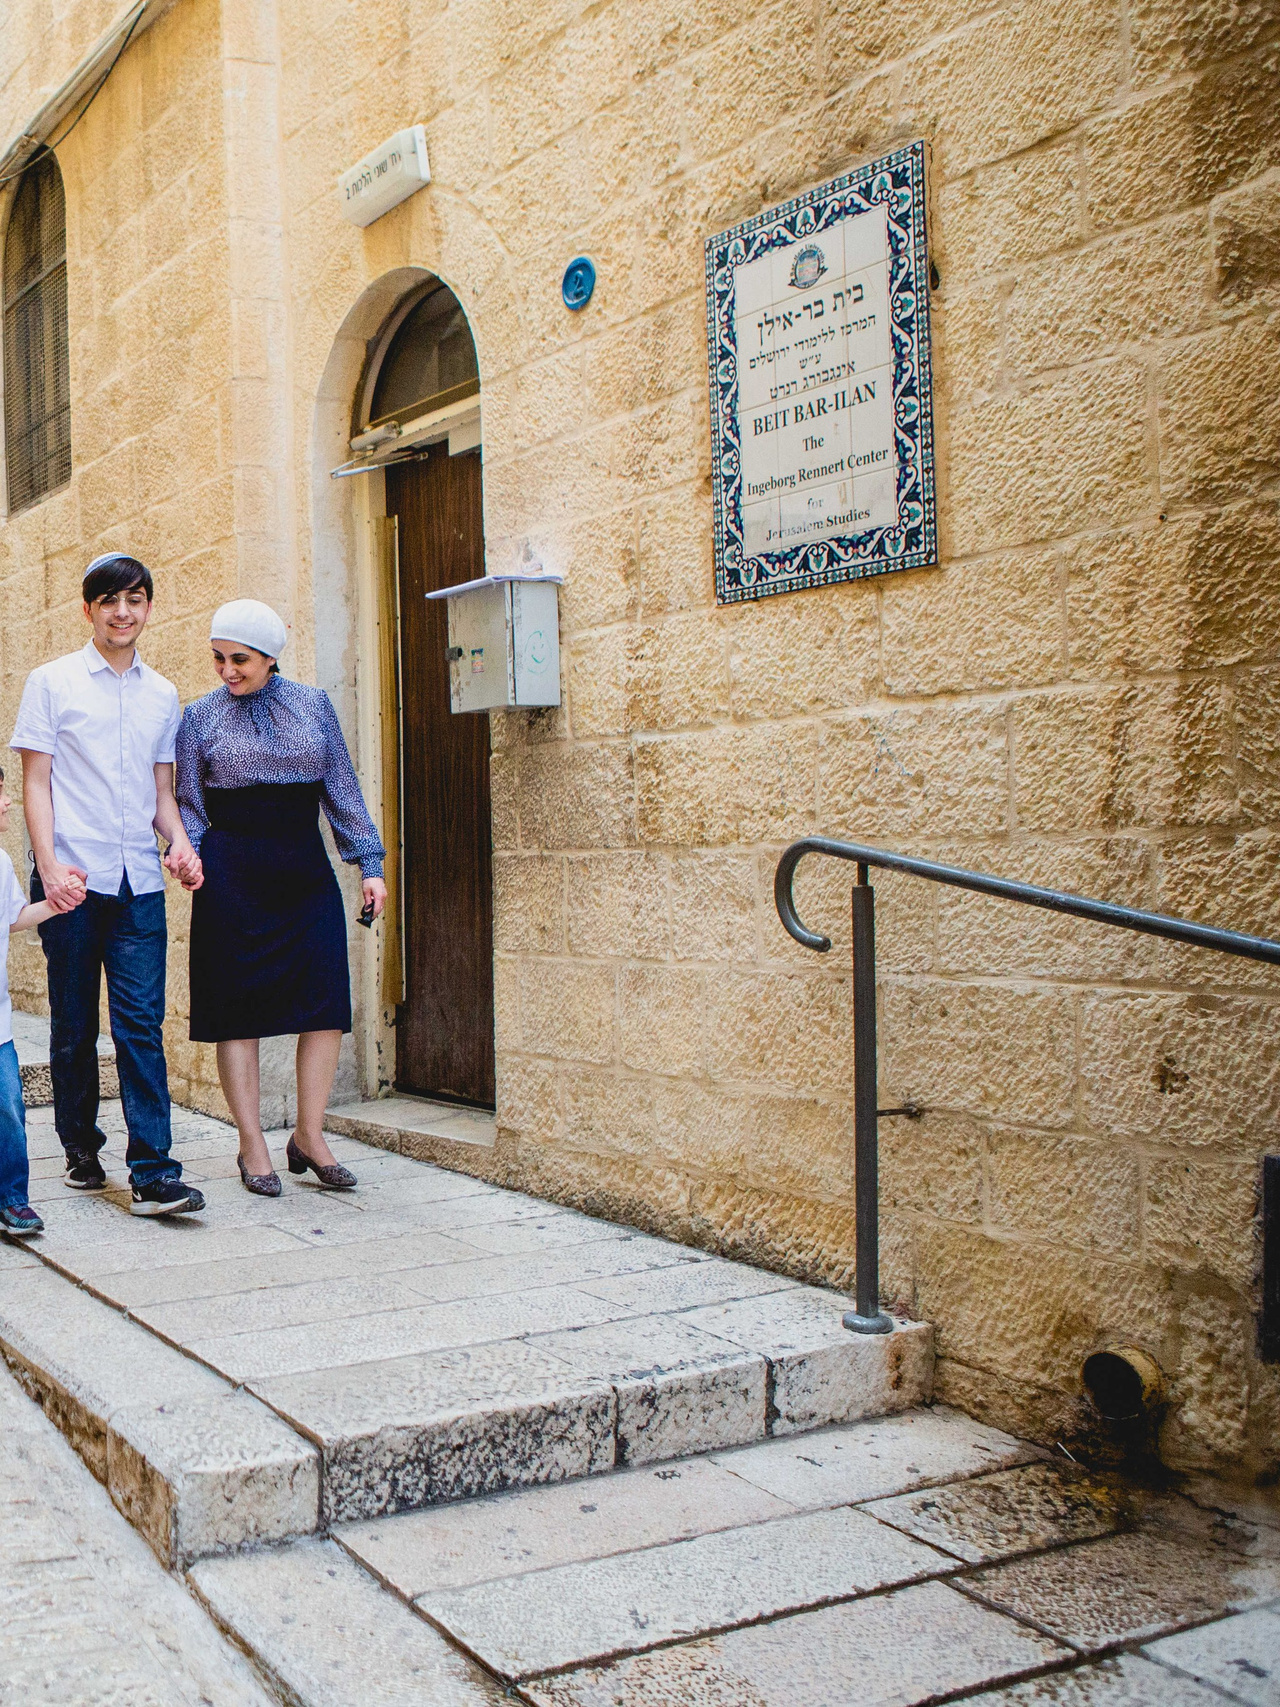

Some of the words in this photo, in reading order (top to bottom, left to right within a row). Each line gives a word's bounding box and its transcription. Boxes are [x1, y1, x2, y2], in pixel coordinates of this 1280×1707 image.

[832, 283, 865, 312] בית
[757, 299, 825, 346] בר-אילן
[840, 314, 876, 337] המרכז
[794, 326, 836, 351] ללימודי
[749, 346, 790, 369] ירושלים
[803, 360, 856, 389] אינגבורג
[770, 380, 798, 400] רנרט
[752, 408, 790, 437] BEIT
[793, 380, 877, 424] BAR-ILAN
[802, 435, 825, 452] The
[747, 474, 796, 497] Ingeborg
[798, 458, 845, 483] Rennert
[847, 448, 889, 469] Center
[807, 497, 824, 511] for
[826, 507, 871, 528] Studies
